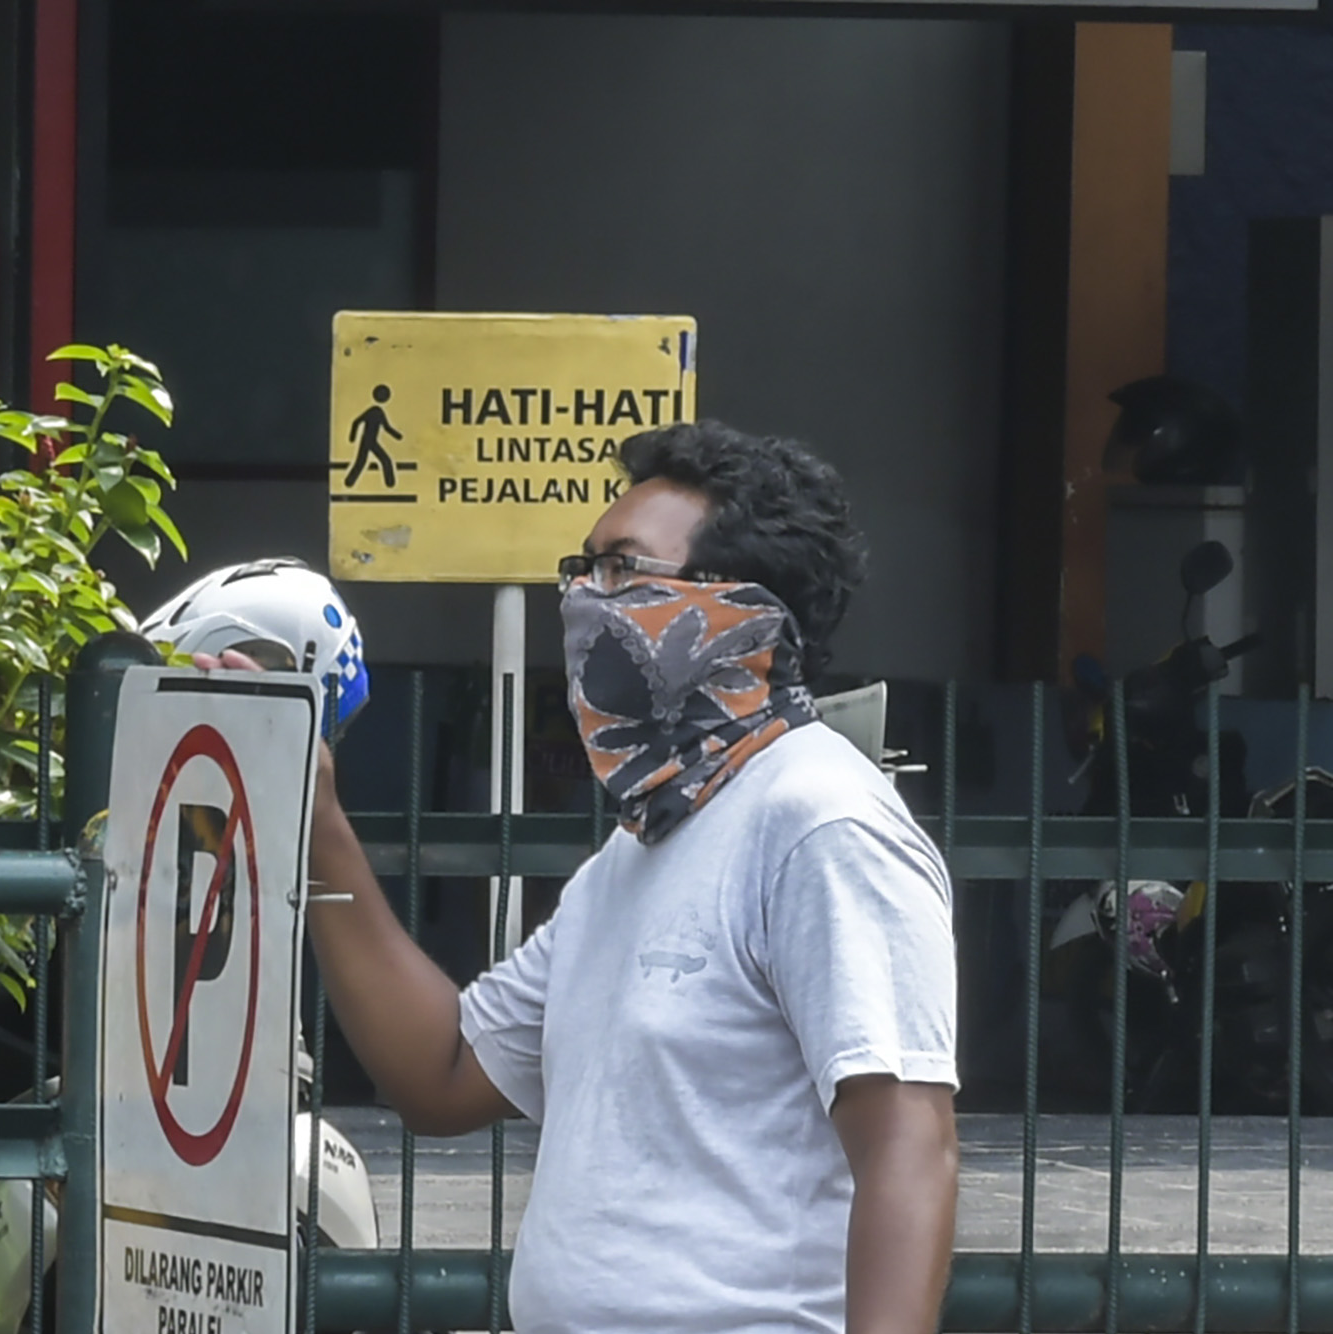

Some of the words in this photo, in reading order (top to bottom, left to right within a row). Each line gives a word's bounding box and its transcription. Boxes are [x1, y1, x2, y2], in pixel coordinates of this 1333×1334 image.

[440, 387, 683, 426] HATI-HATI
[476, 437, 620, 464] LINTASA
[438, 477, 590, 504] PEJALAN
[124, 1246, 203, 1296] DILARANG
[206, 1261, 265, 1308] PARKIR
